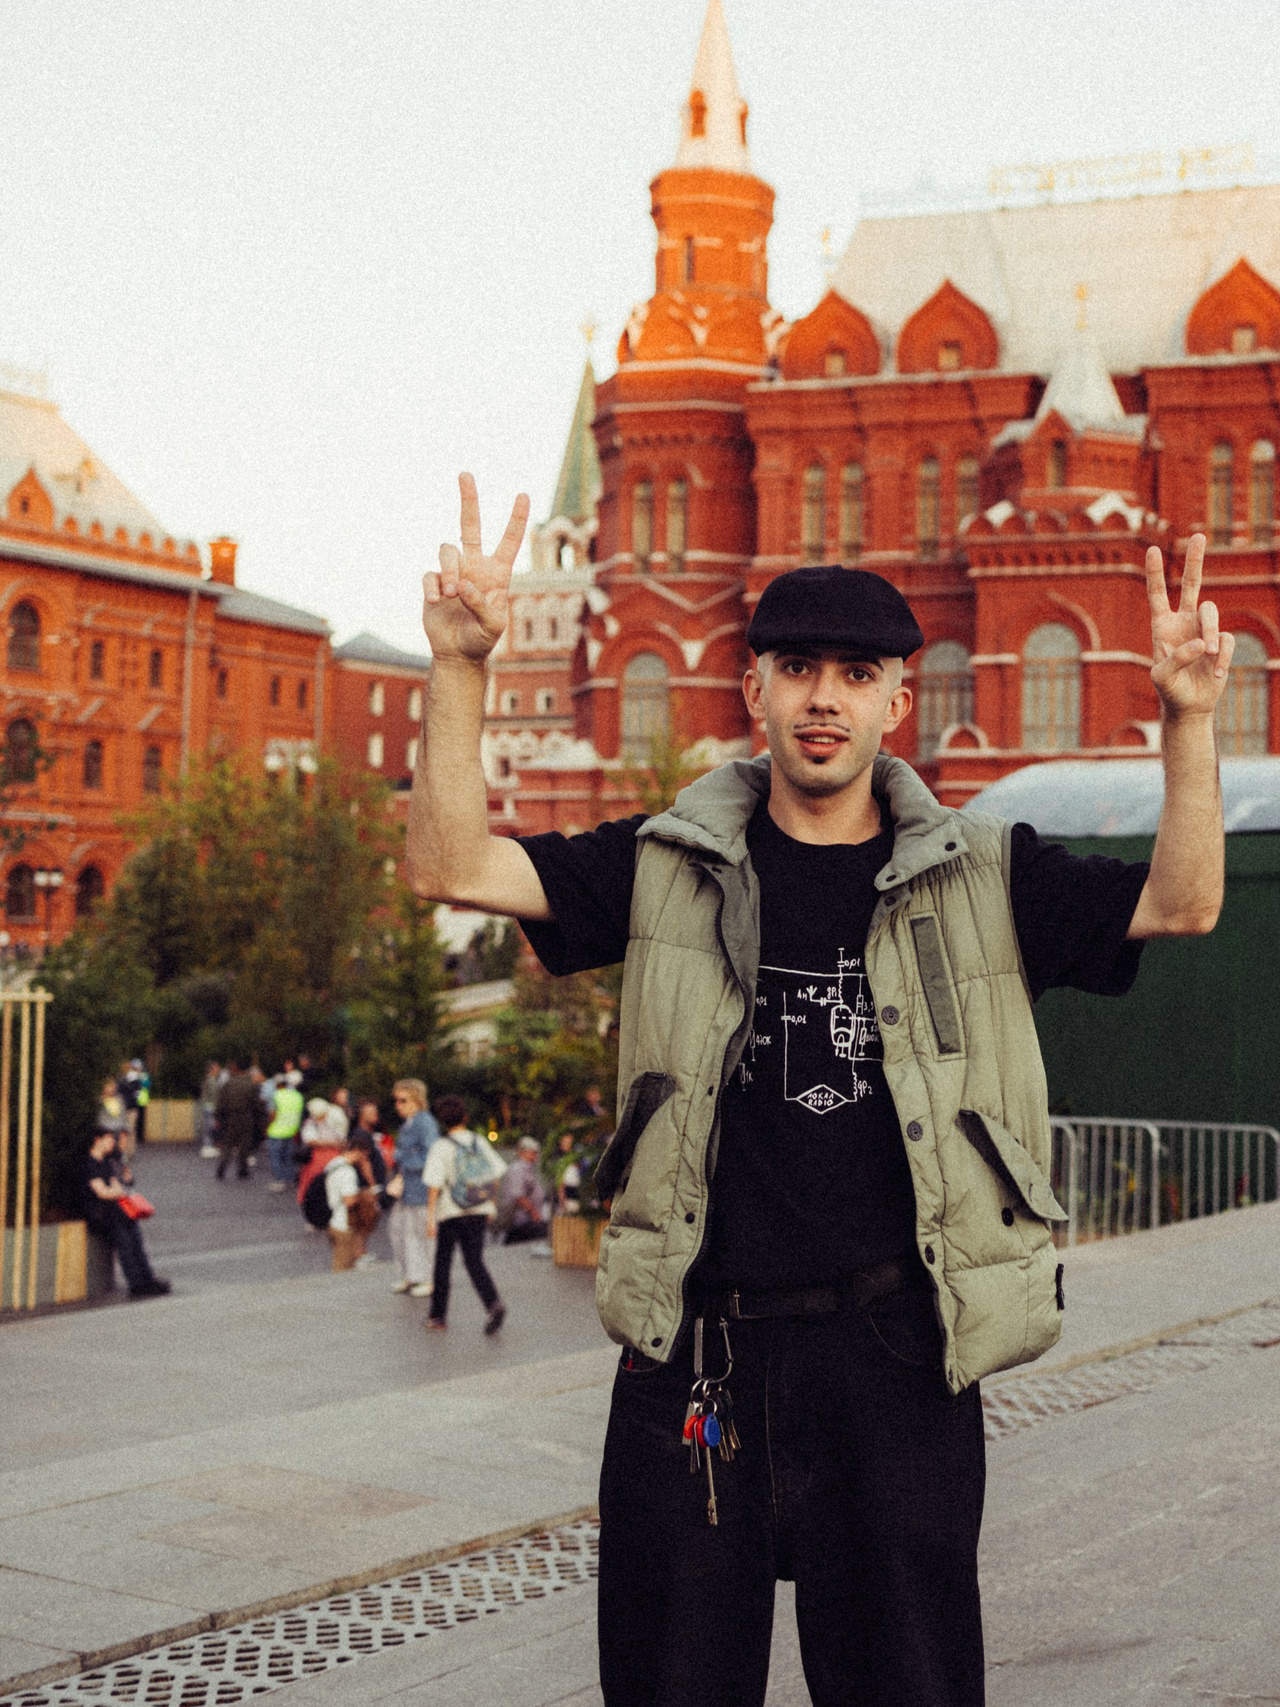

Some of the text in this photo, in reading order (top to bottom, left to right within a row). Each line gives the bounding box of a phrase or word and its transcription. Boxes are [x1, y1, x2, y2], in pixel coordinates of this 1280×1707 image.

[844, 957, 860, 969] 0,01
[790, 1015, 807, 1026] 0,01
[808, 1099, 834, 1107] RADIO
